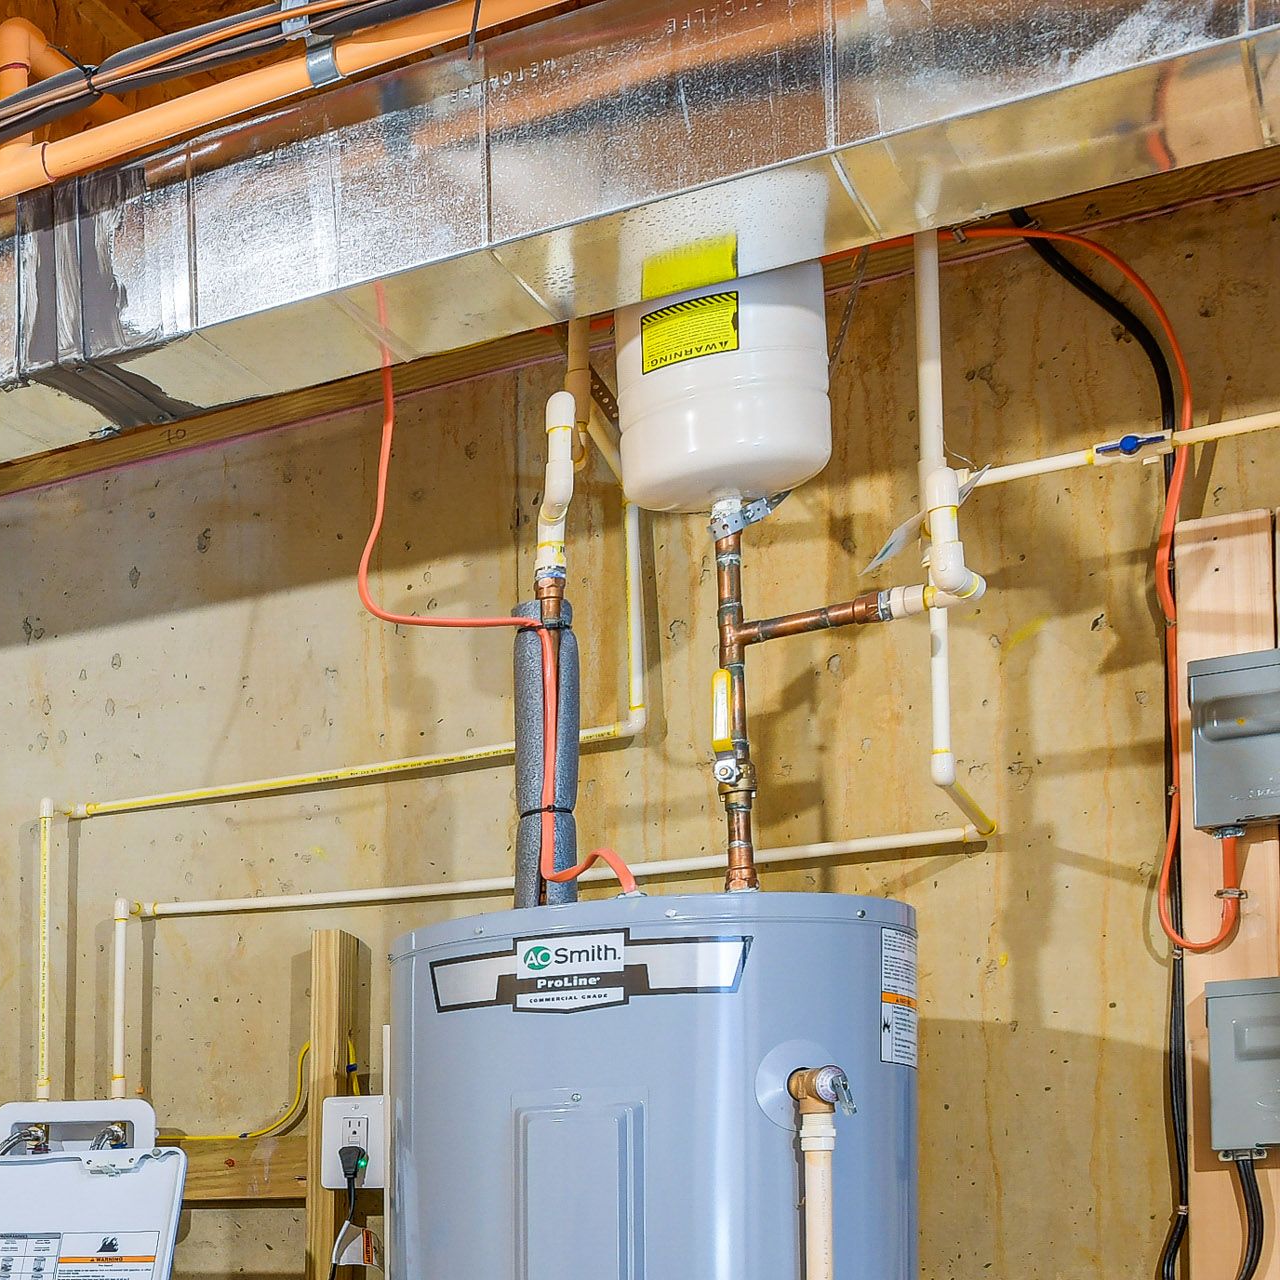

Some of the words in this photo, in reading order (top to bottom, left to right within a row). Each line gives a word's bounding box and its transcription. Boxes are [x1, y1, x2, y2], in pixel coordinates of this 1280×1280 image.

[537, 976, 597, 989] ProLine
[529, 995, 578, 1004] COMMERCIAL
[581, 993, 608, 1001] GRADE
